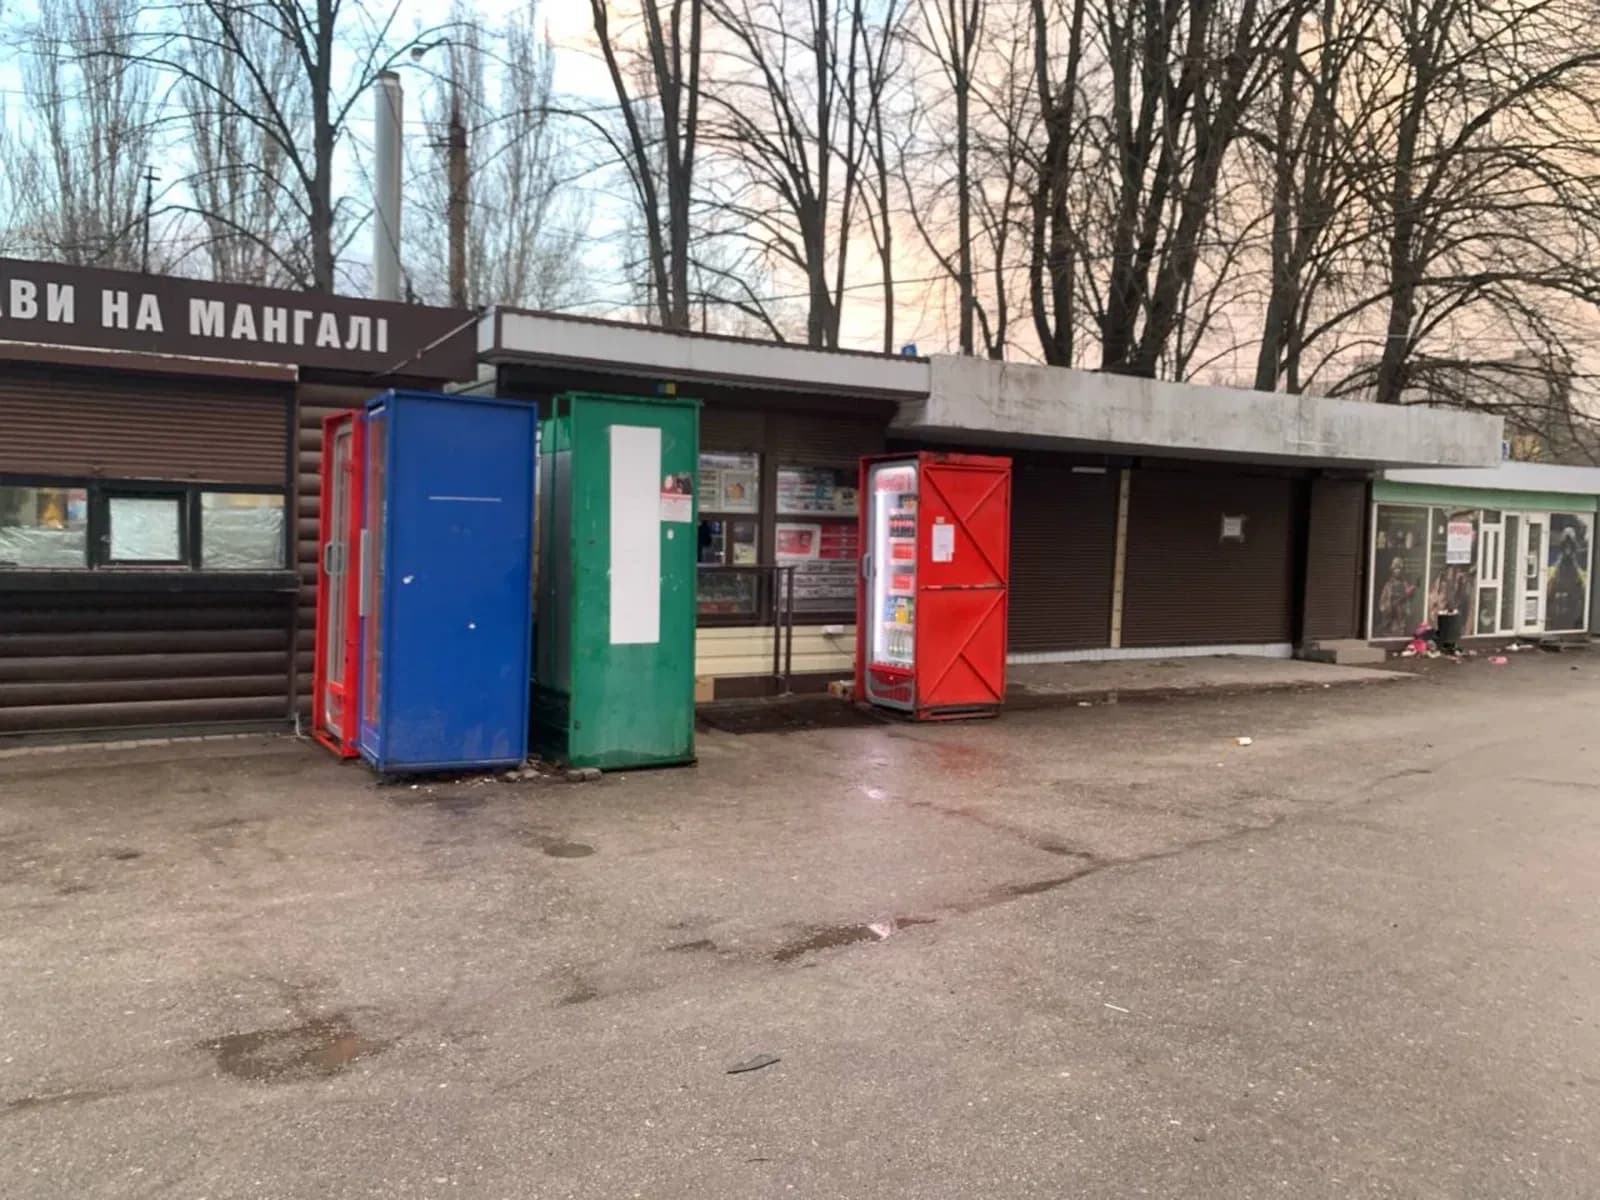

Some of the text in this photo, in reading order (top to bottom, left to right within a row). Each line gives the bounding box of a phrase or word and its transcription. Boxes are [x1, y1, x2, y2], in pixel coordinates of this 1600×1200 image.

[0, 278, 389, 353] ВИ НА МАНГАЛІ
